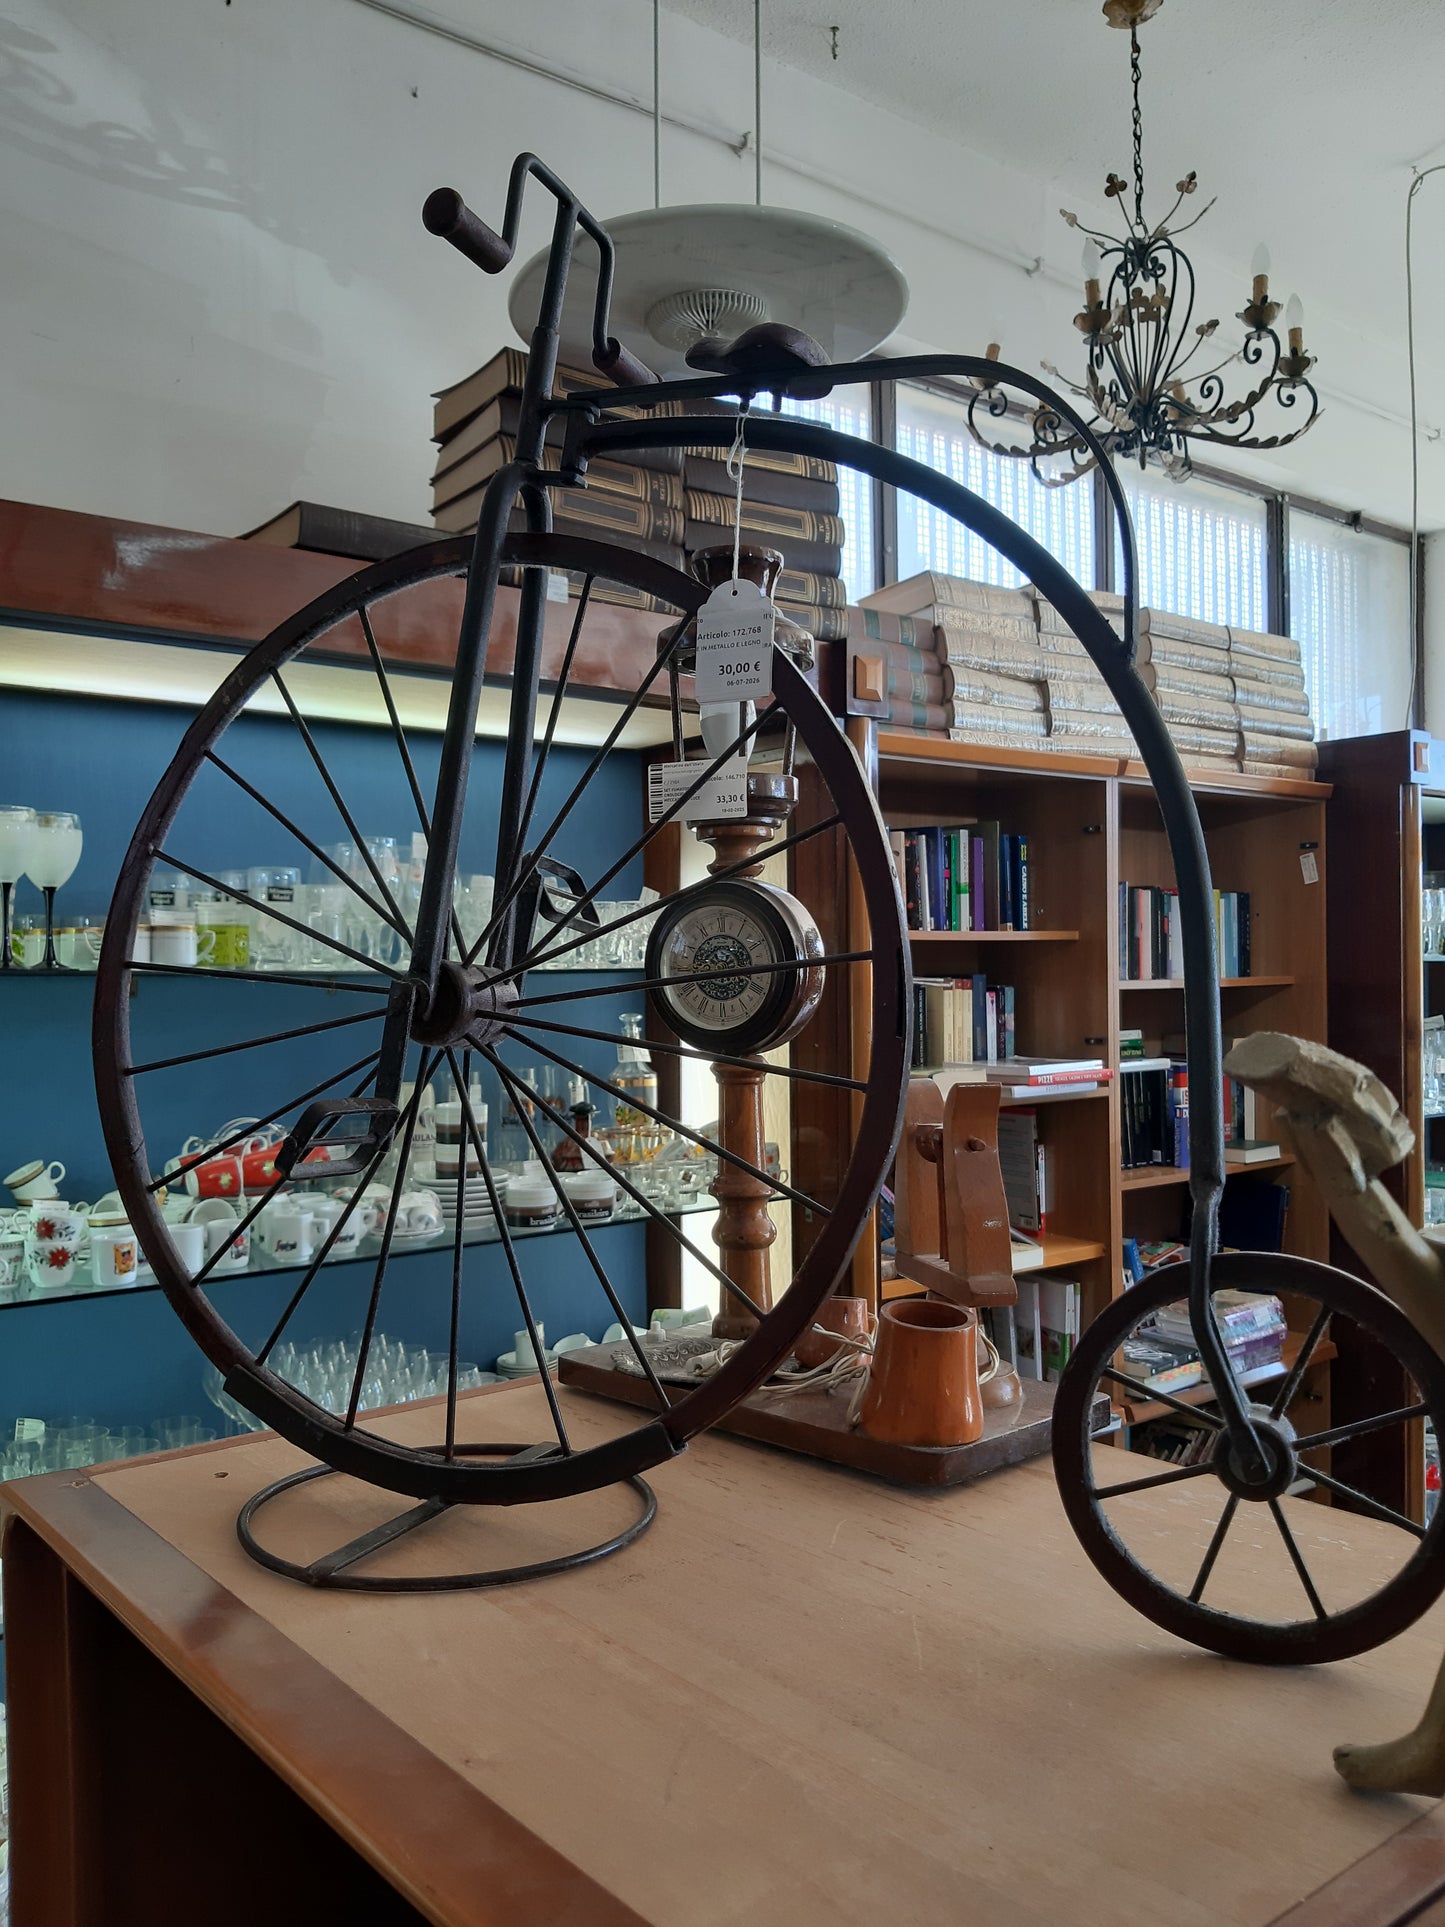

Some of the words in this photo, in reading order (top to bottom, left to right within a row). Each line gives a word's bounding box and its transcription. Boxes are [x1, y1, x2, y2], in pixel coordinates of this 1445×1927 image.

[697, 630, 731, 641] Articolo:
[708, 642, 735, 651] METALLO
[741, 639, 761, 647] LEGNO
[718, 662, 750, 676] 30,00
[753, 661, 761, 672] €
[716, 794, 738, 804] 33,30
[739, 793, 745, 802] €
[1038, 1075, 1053, 1084] PIZZE
